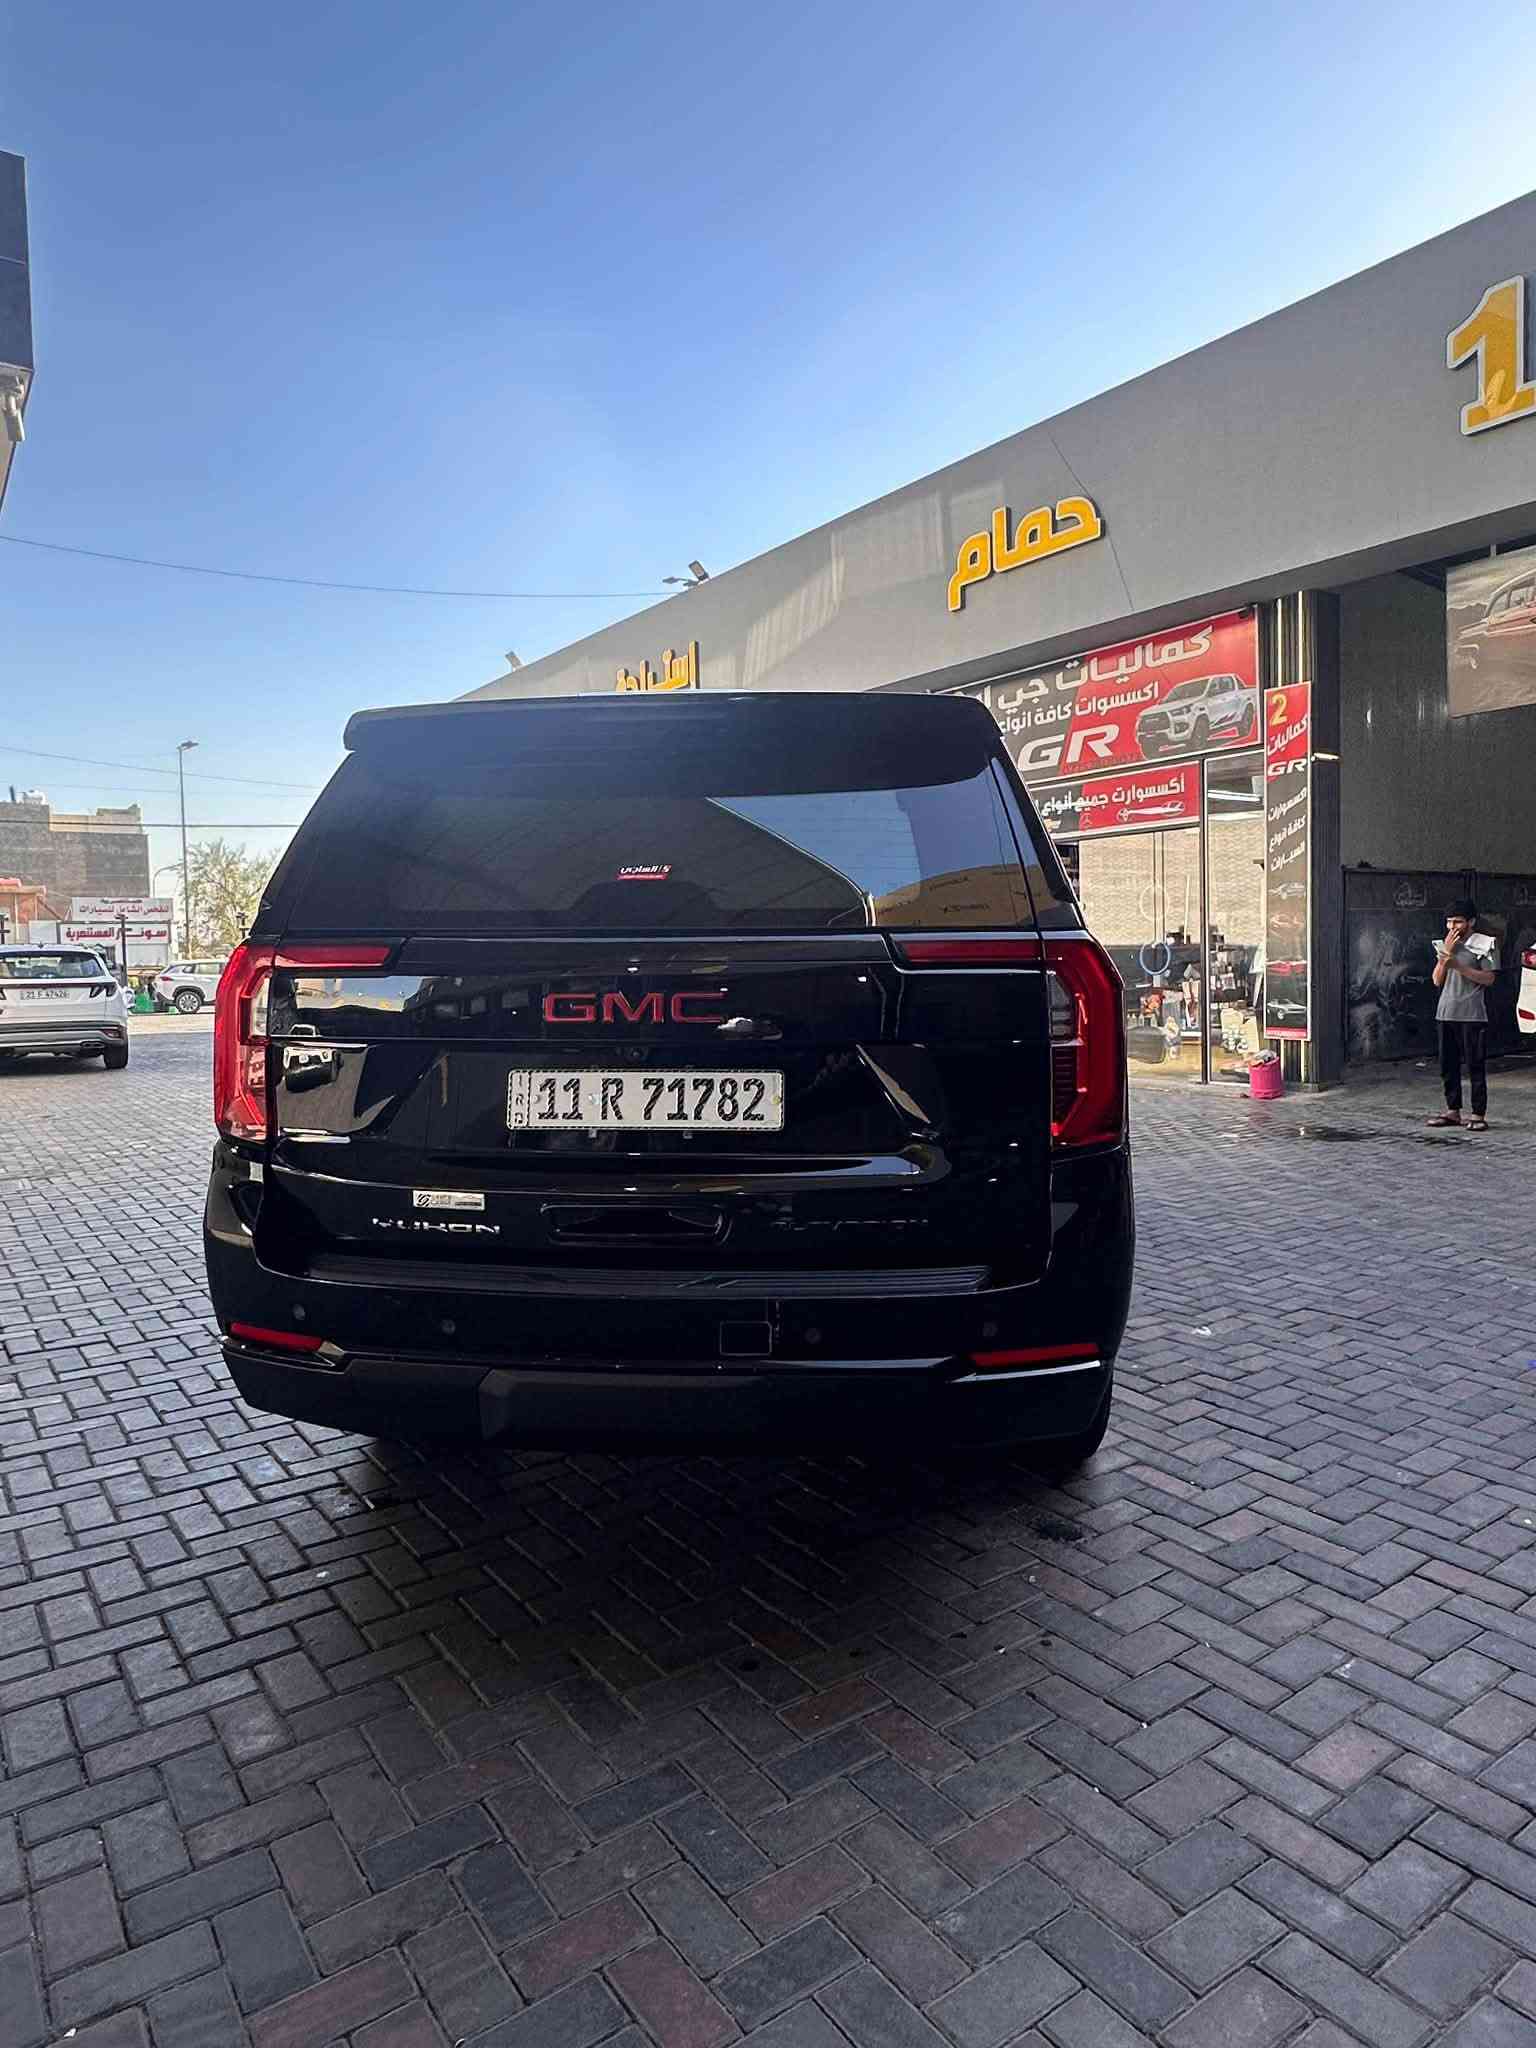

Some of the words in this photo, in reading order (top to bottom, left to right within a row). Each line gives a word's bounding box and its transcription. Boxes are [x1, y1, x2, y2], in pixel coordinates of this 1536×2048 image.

[948, 496, 1101, 612] حمام
[1055, 624, 1213, 691] كماليات
[1034, 701, 1073, 726] كافة
[1271, 693, 1288, 726] 2
[1017, 723, 1120, 772] GR
[1267, 759, 1307, 776] GR
[543, 991, 726, 1024] GMC
[538, 1078, 584, 1121] 11
[601, 1078, 623, 1121] R
[642, 1077, 765, 1122] 71782
